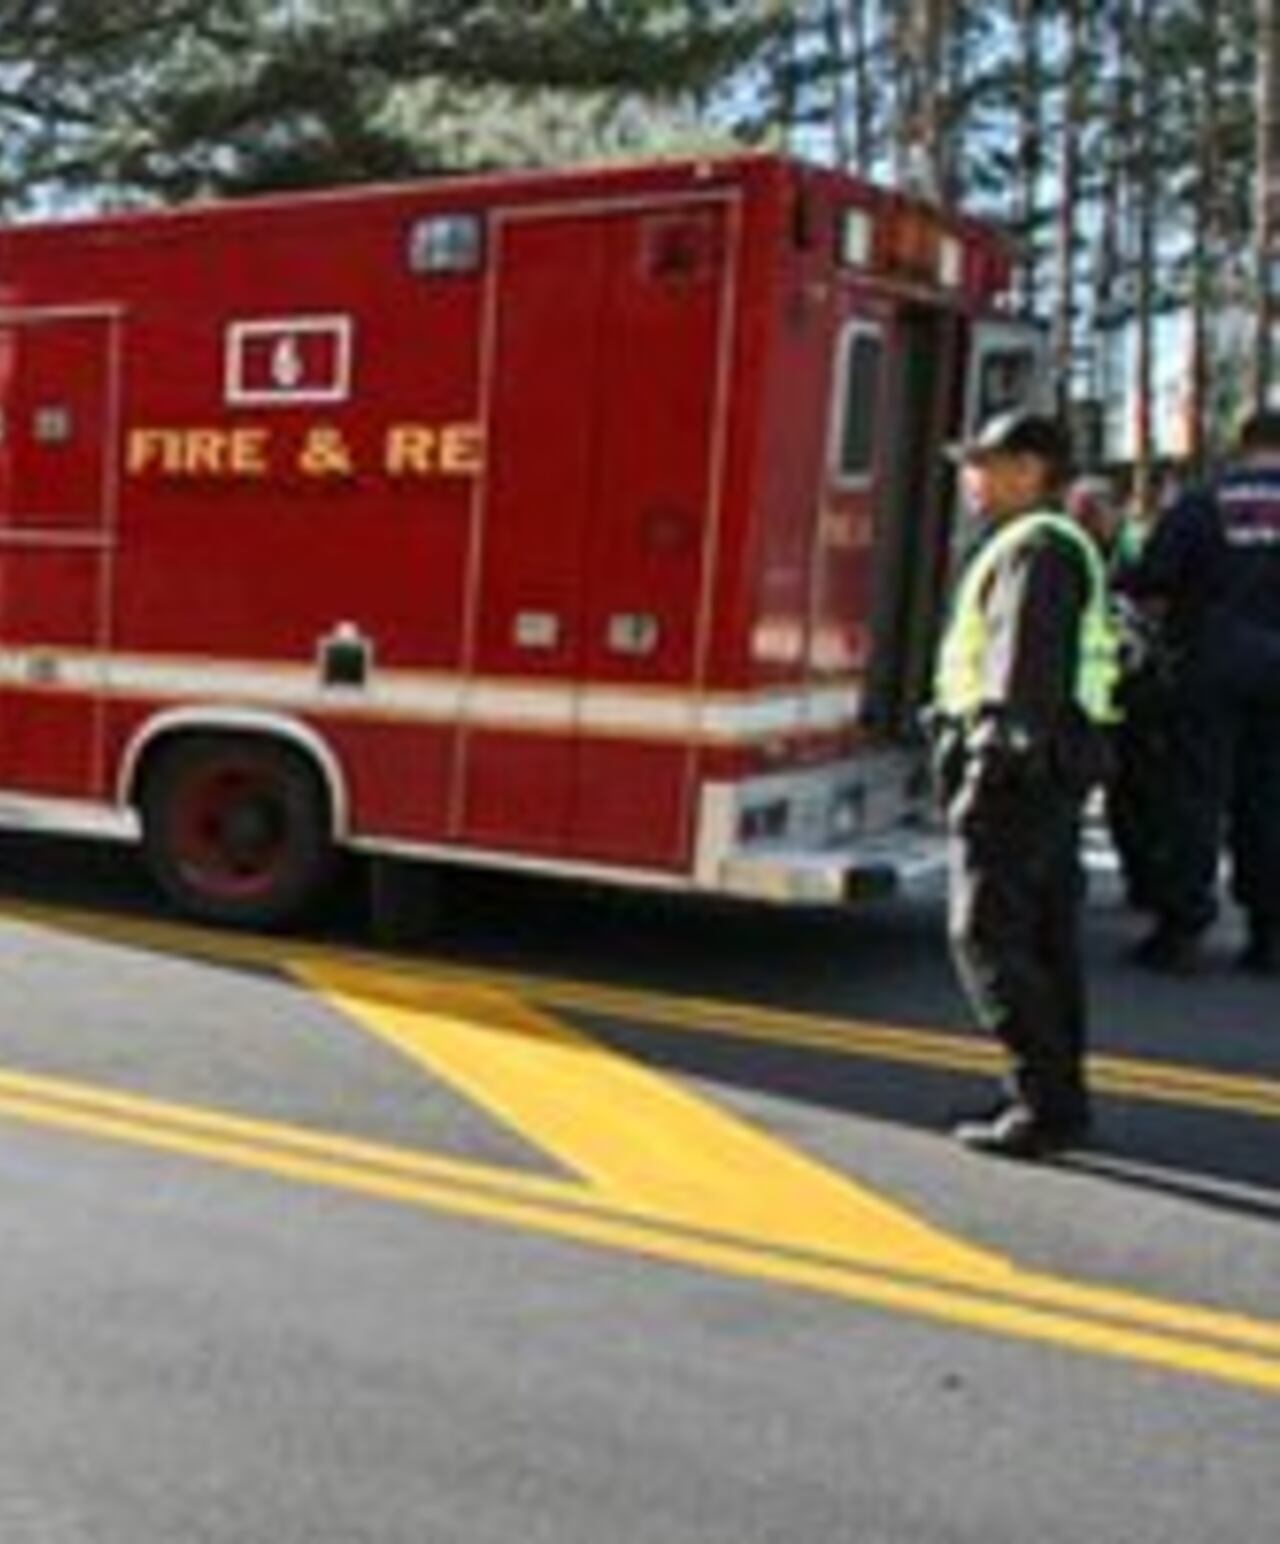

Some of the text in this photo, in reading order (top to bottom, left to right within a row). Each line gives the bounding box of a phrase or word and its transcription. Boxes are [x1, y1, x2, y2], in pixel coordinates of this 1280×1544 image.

[271, 338, 301, 387] 6
[125, 423, 483, 474] FIRE & RE
